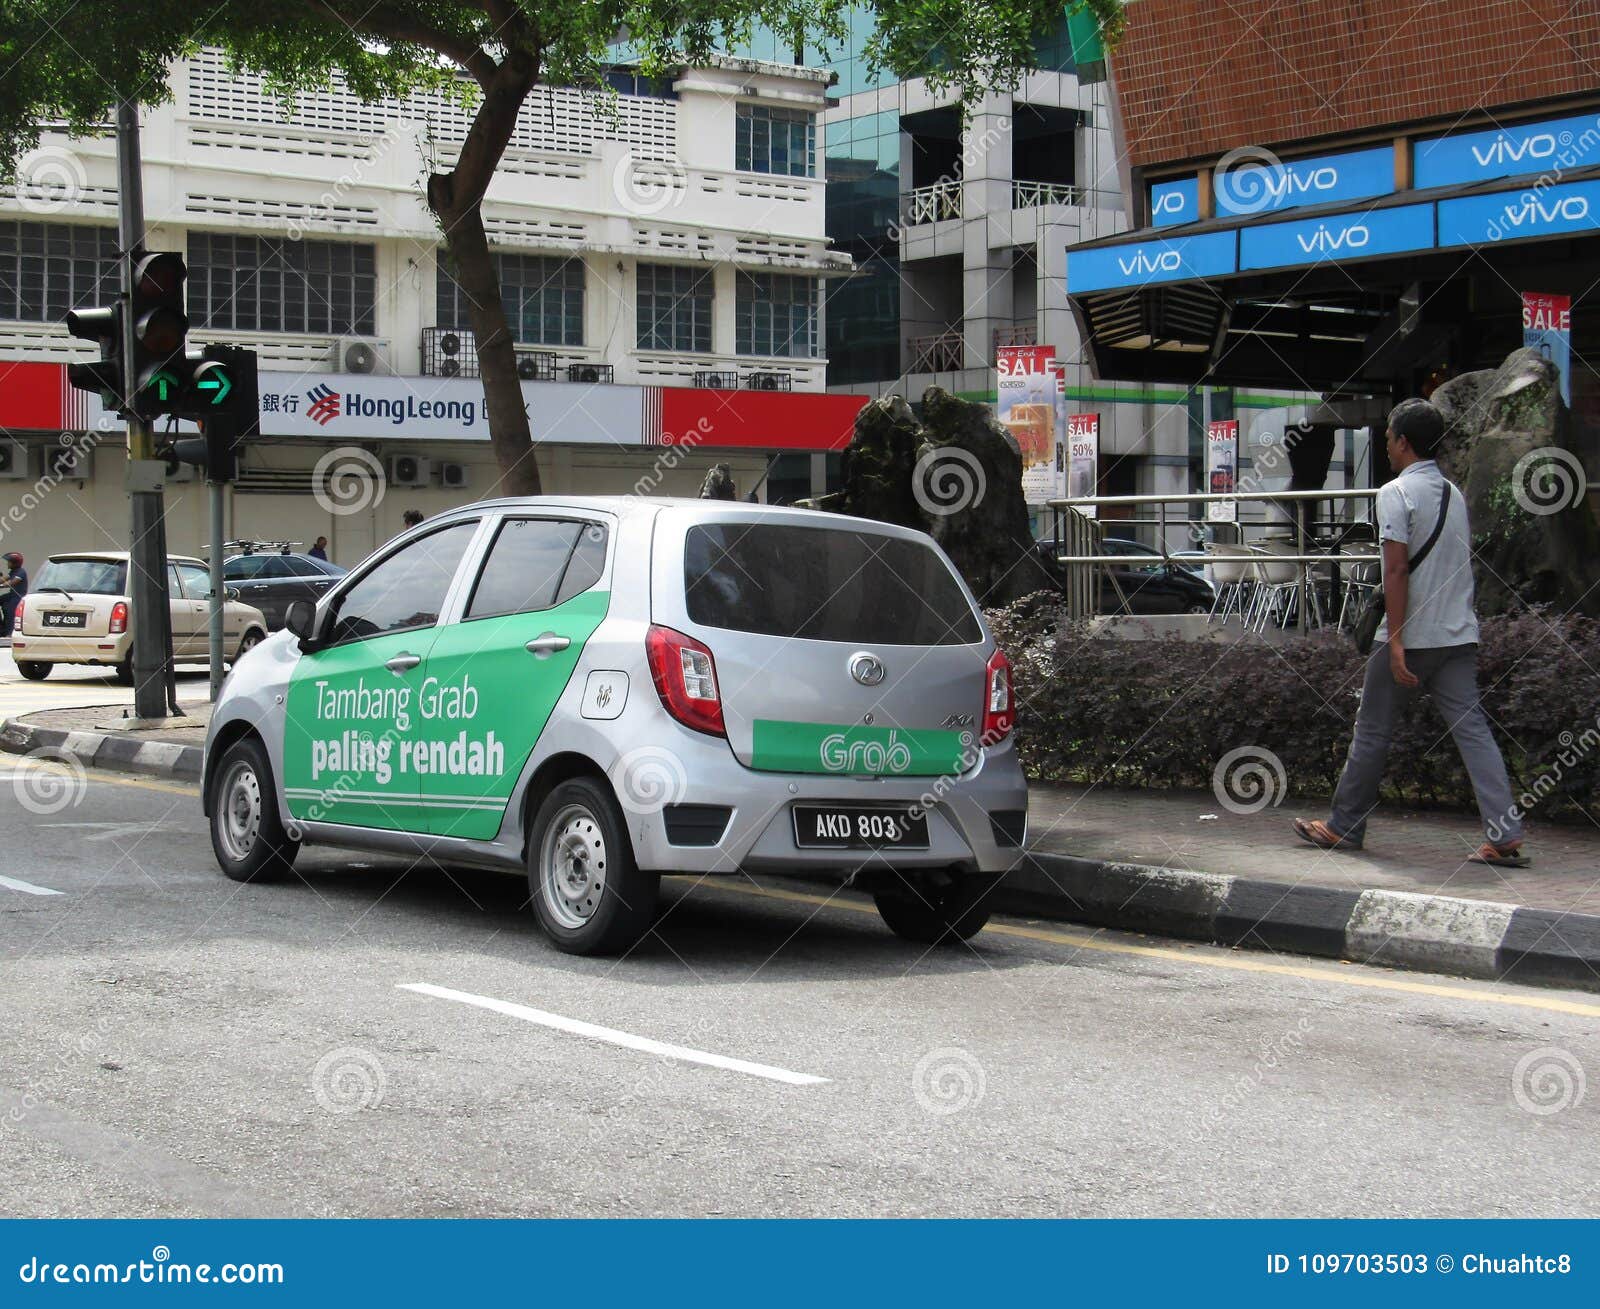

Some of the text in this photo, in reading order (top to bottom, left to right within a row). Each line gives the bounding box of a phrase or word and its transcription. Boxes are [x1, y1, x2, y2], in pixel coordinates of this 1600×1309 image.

[1472, 134, 1556, 166] vivo
[1264, 167, 1338, 196] vivo
[1505, 195, 1588, 225] vivo
[1297, 224, 1370, 253] vivo
[1118, 249, 1181, 275] vivo
[1522, 307, 1570, 332] SALE
[997, 357, 1057, 376] SALE
[257, 393, 300, 414] 銀行
[346, 393, 475, 426] HongLeong
[1068, 422, 1098, 436] SALE
[1208, 428, 1237, 441] SALE
[1072, 443, 1094, 457] 50%
[315, 673, 479, 731] Tambang Grab
[312, 730, 504, 784] paling rendah
[820, 729, 911, 772] Grab
[816, 814, 896, 838] AKD 803
